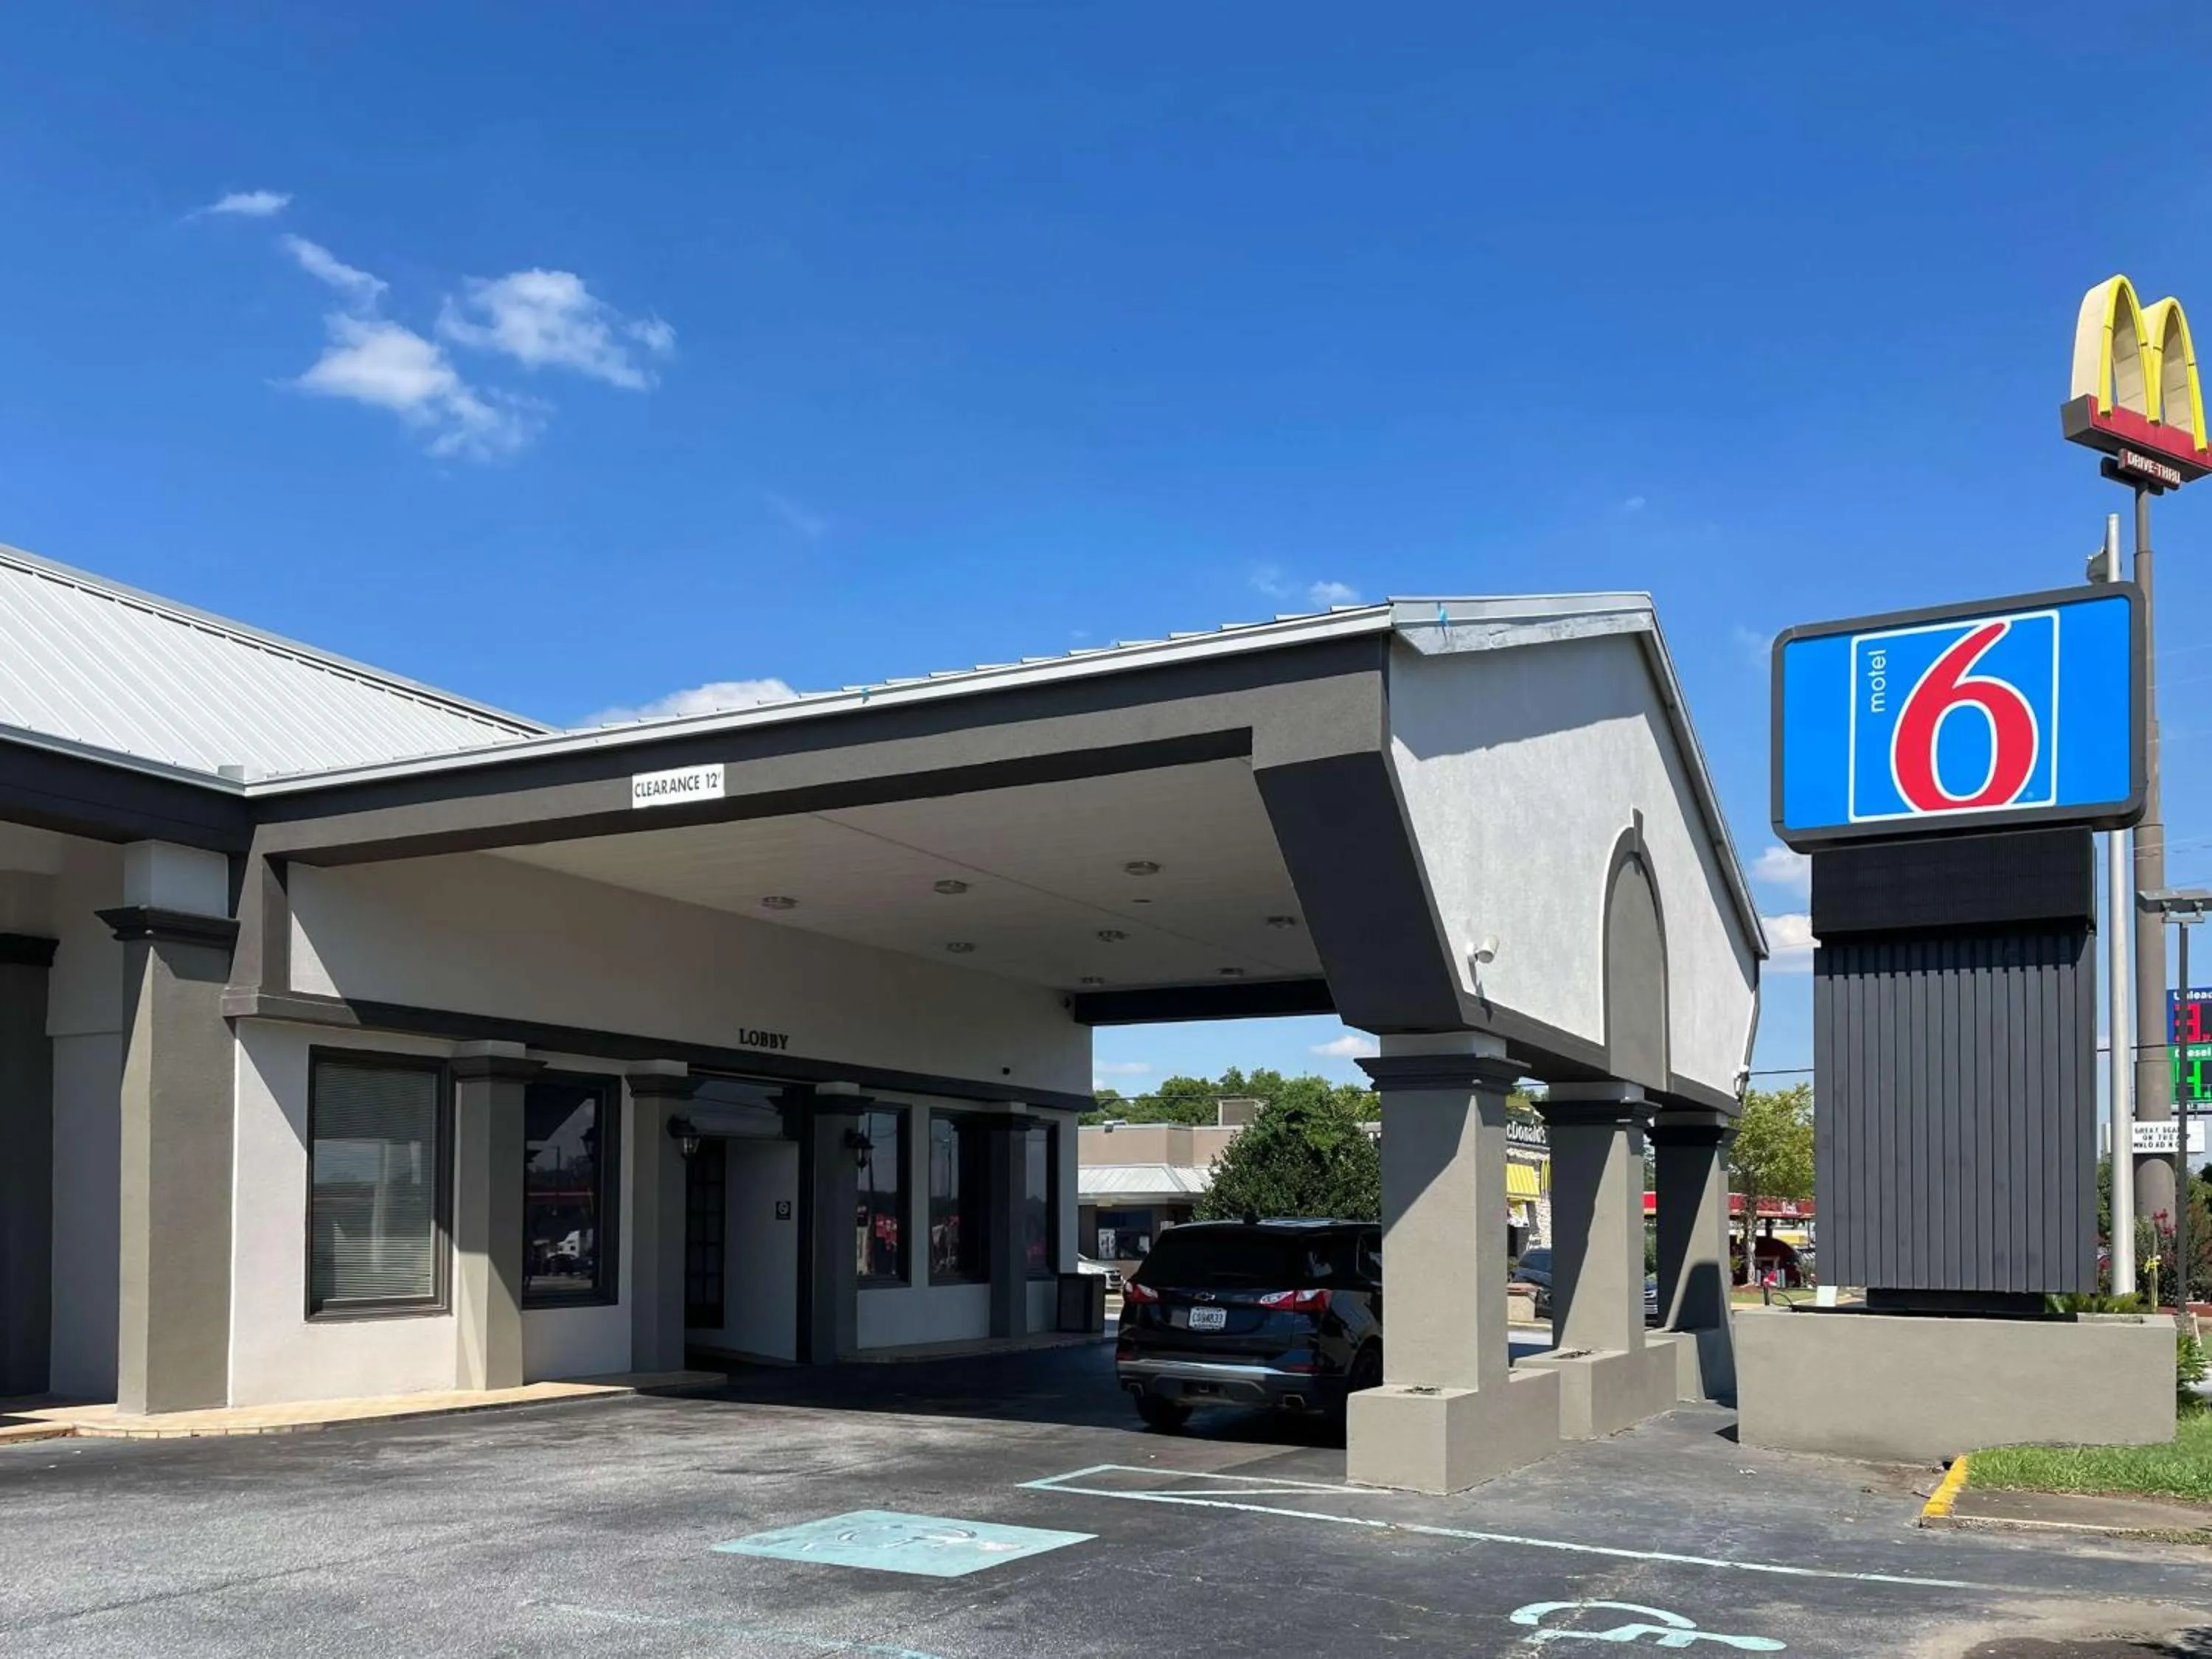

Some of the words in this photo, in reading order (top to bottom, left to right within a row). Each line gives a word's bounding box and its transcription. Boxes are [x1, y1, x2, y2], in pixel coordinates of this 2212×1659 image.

[2127, 451, 2181, 484] DRIVE-THRU
[1868, 649, 1887, 714] motel
[1890, 620, 2039, 814] 6
[634, 774, 700, 798] CLEARANCE
[739, 1028, 789, 1050] LOBBY
